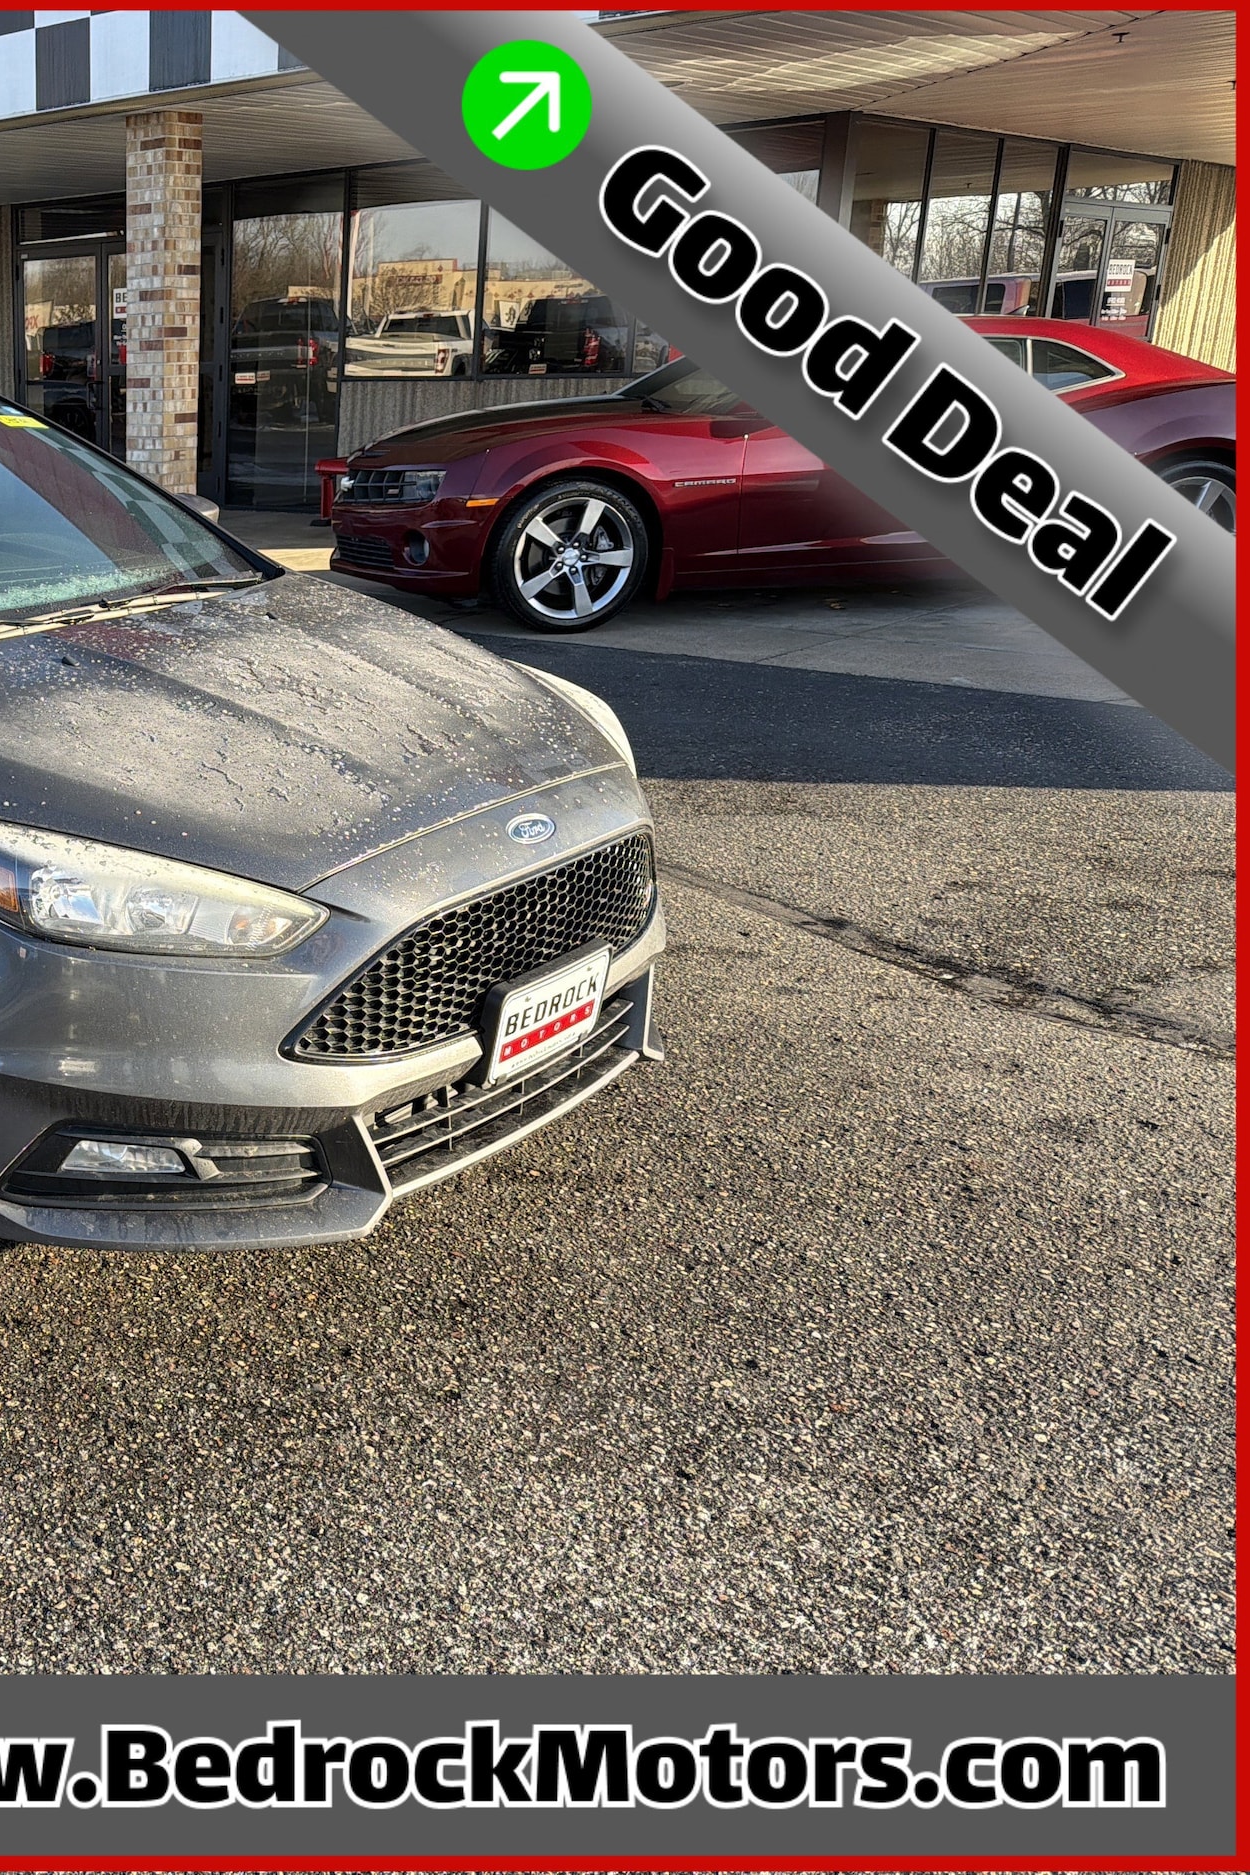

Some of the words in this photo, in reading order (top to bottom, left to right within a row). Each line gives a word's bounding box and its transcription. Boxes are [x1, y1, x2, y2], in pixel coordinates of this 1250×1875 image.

[674, 478, 737, 488] CAMARO
[518, 820, 547, 838] Ford
[504, 972, 599, 1037] BEDROCK
[503, 1005, 591, 1057] MOTORS
